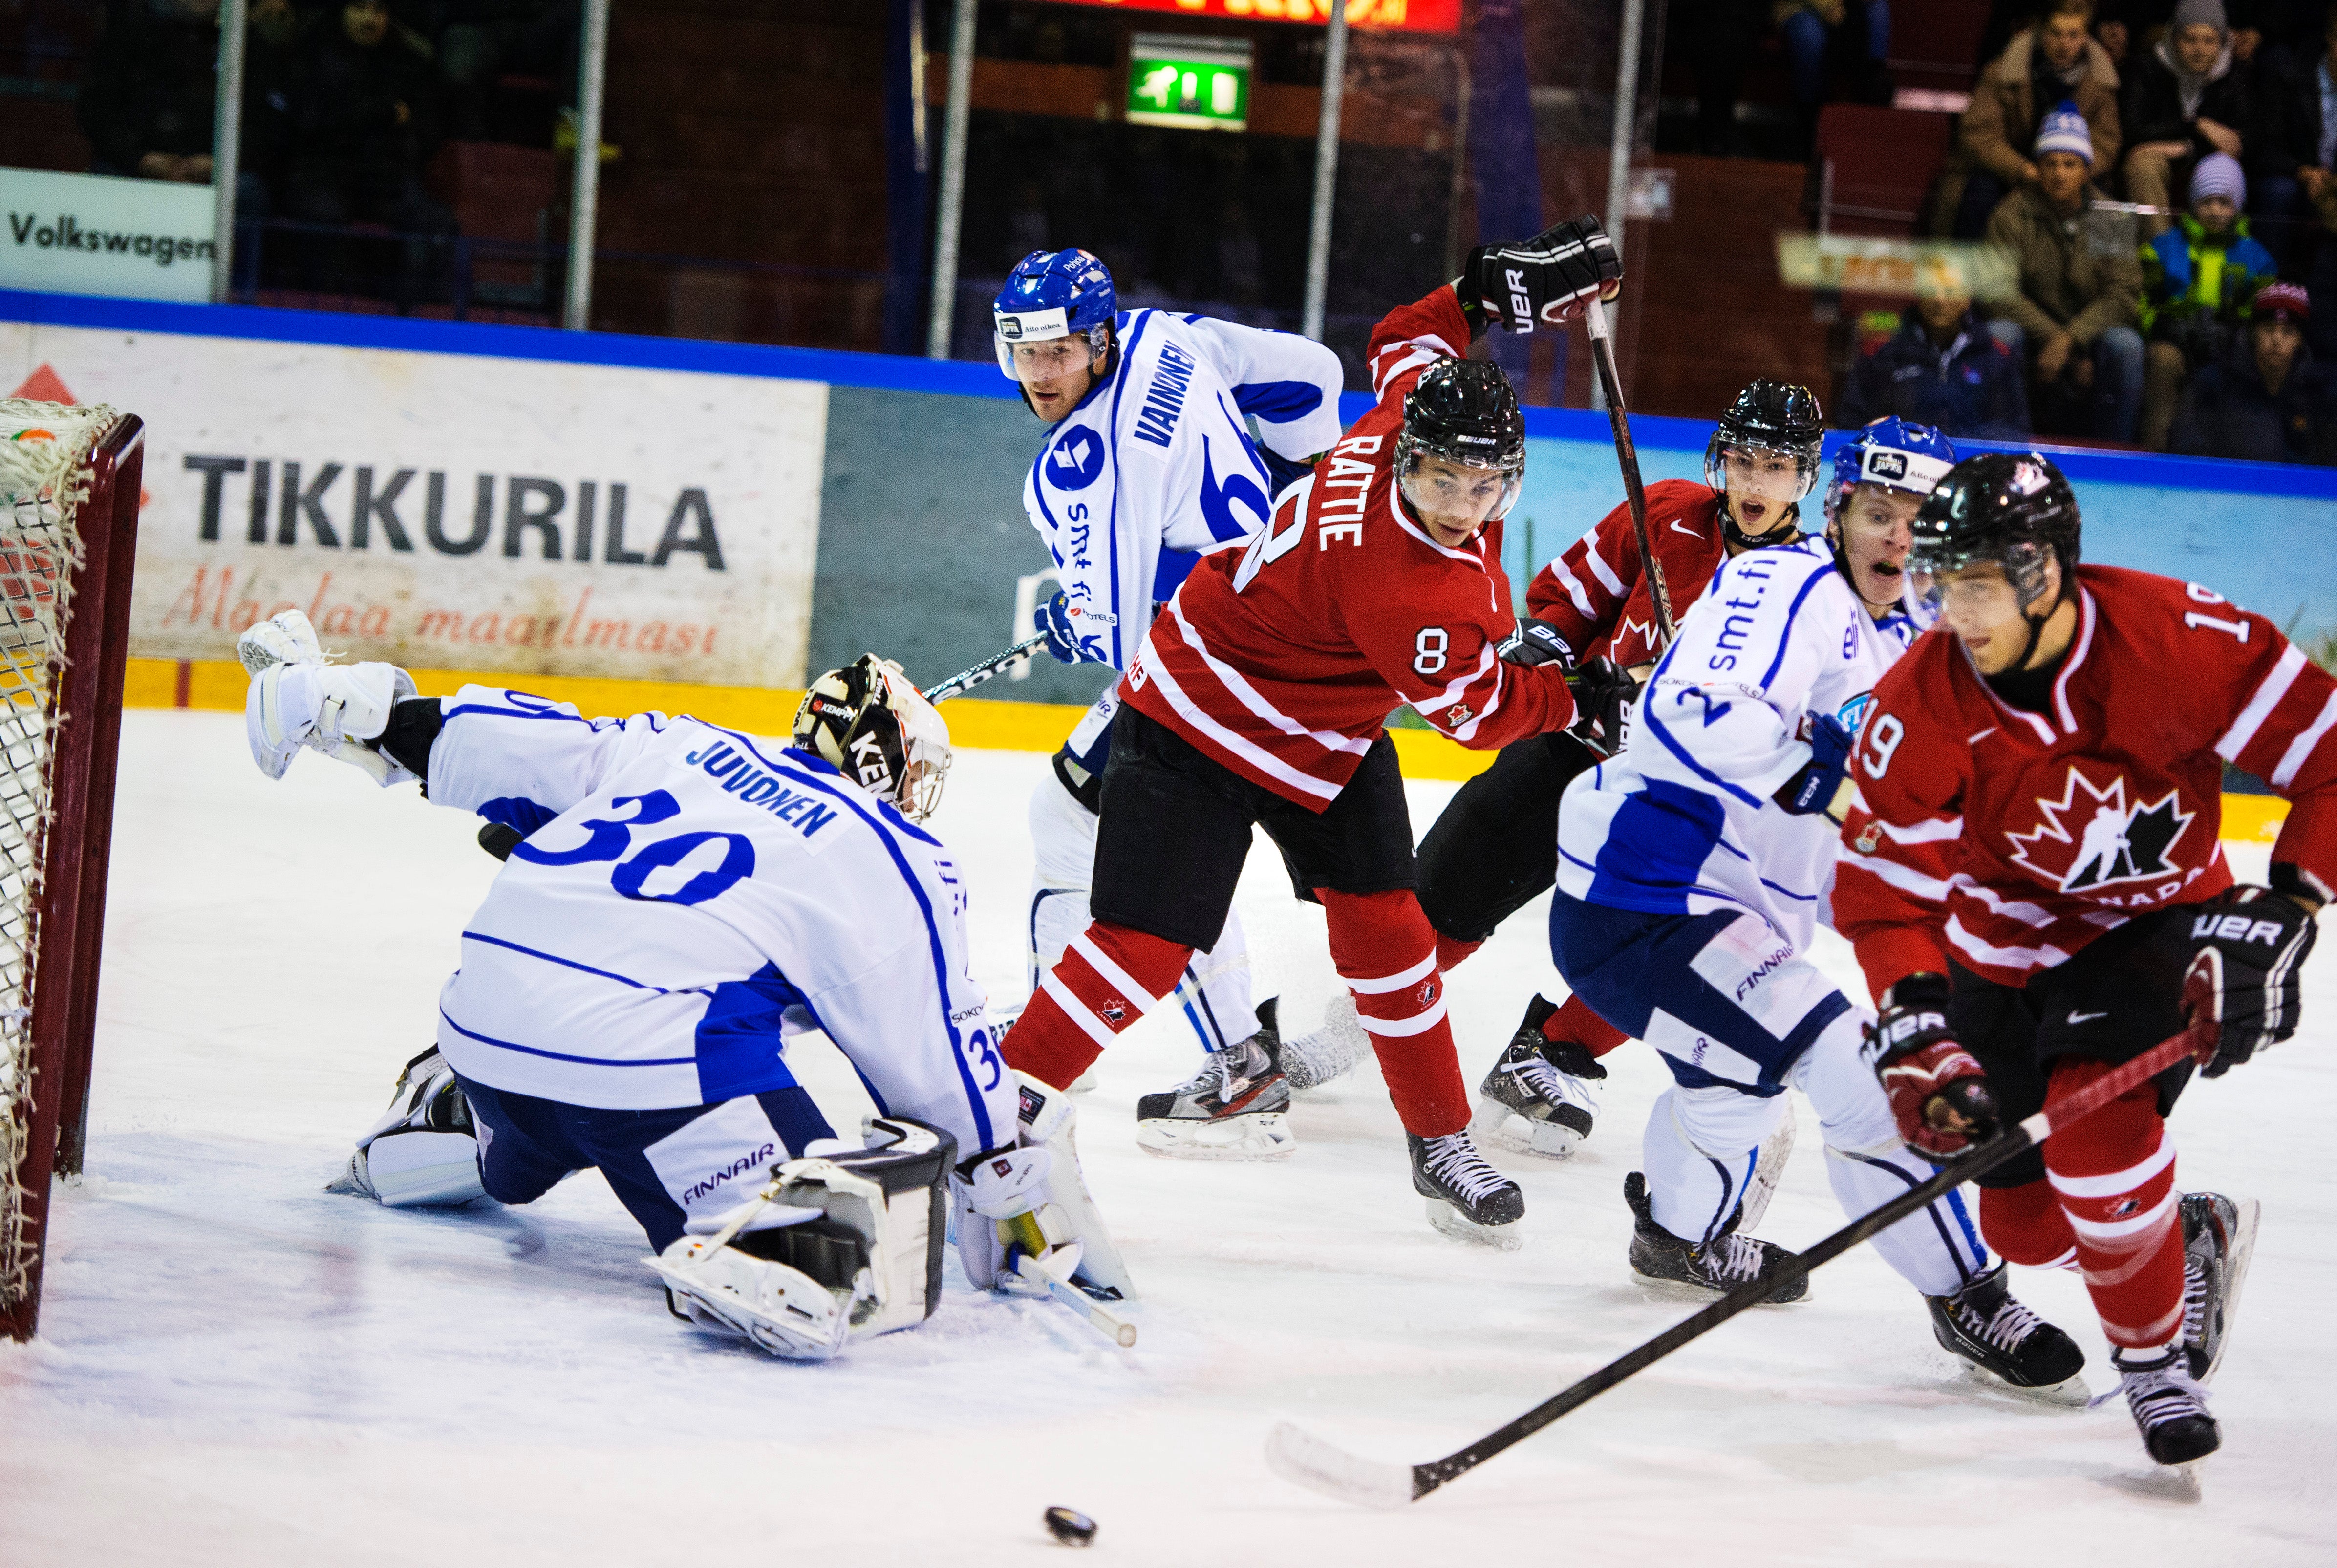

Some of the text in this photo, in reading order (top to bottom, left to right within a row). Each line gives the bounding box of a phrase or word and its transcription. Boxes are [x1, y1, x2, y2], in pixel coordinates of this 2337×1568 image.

[8, 210, 215, 267] Volkswagen
[1134, 339, 1196, 448] VAINONEN
[1457, 434, 1497, 445] BAUER
[183, 454, 727, 572] TIKKURILA
[1319, 435, 1384, 551] RATTIE
[415, 586, 719, 655] maailmasi
[1709, 558, 1778, 671] smt.fi
[1414, 627, 1448, 675] 8
[820, 703, 855, 722] KEMPPI
[1676, 686, 1732, 728] 2
[1853, 697, 1904, 780] 19
[686, 740, 838, 838] JUVONEN
[511, 789, 755, 906] 30
[1420, 997, 1437, 1010] CANADA
[1737, 945, 1794, 1002] FINNAIR
[1096, 1010, 1115, 1028] CANADA
[684, 1143, 775, 1205] FINNAIR
